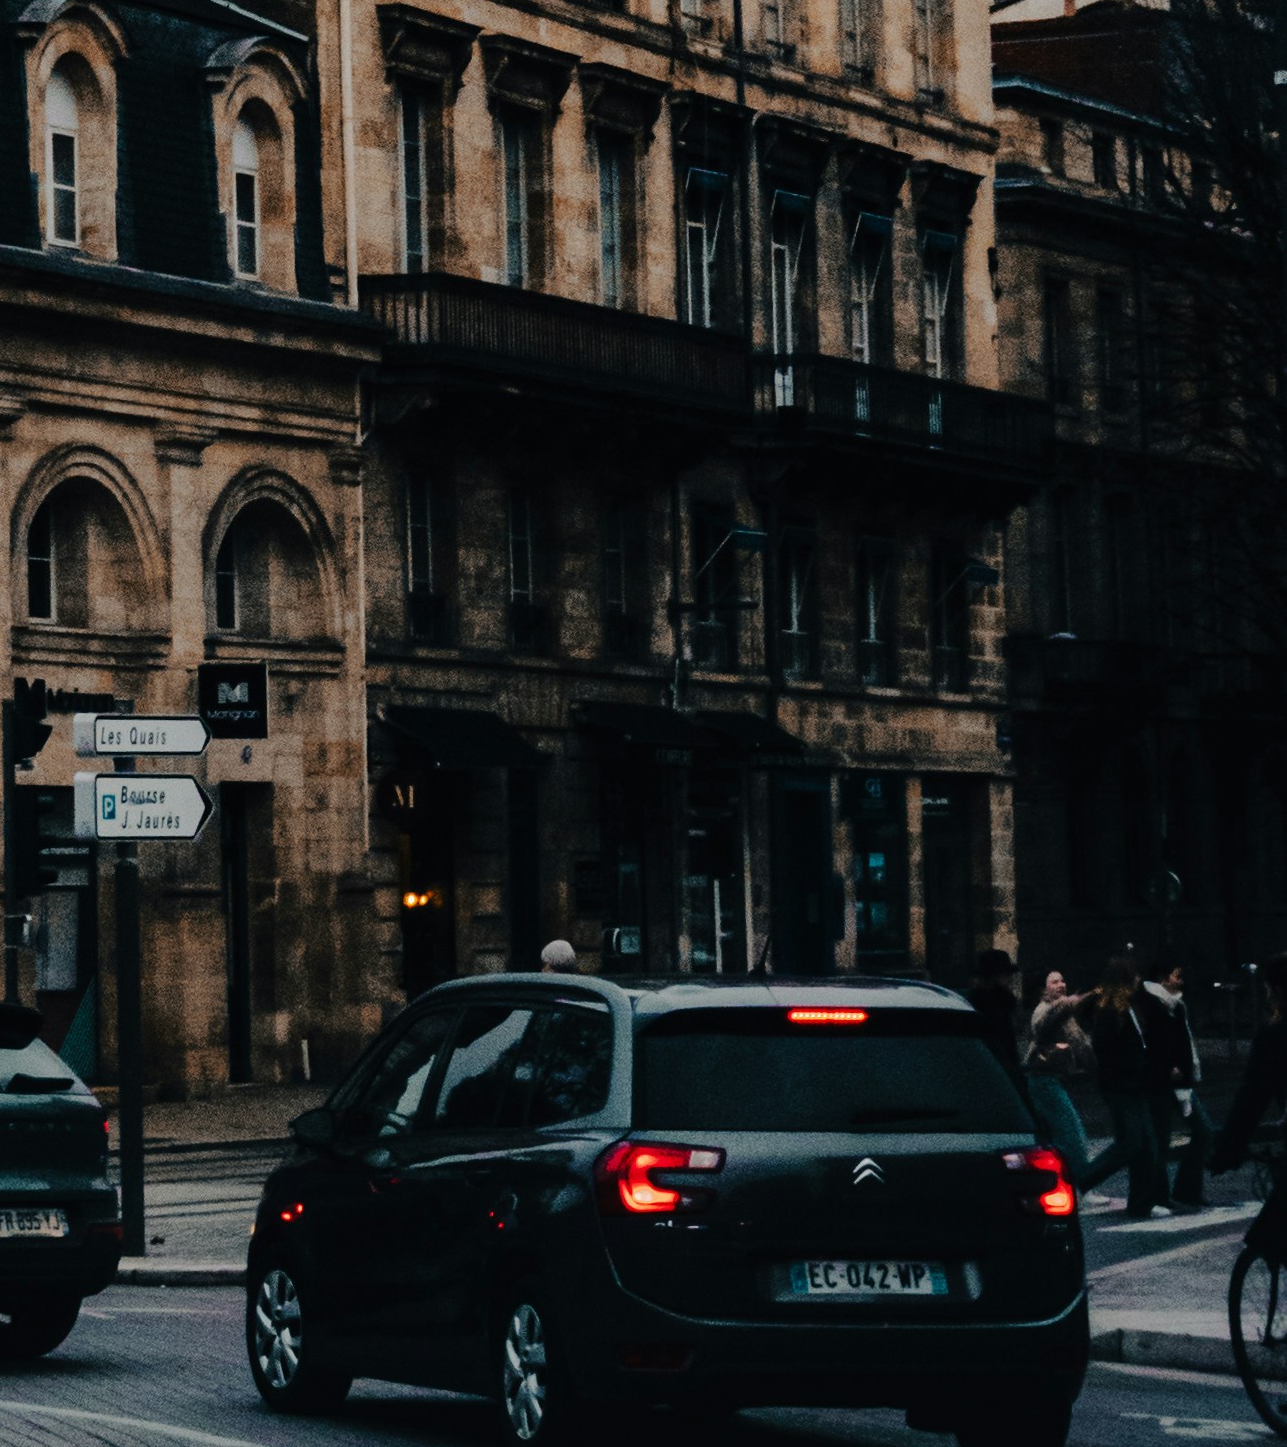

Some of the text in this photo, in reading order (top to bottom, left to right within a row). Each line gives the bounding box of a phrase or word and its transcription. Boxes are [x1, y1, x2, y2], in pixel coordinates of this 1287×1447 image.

[207, 710, 260, 721] Marignan
[100, 727, 167, 745] Les Quais
[121, 786, 166, 804] Bourse
[136, 810, 180, 829] Jaurès
